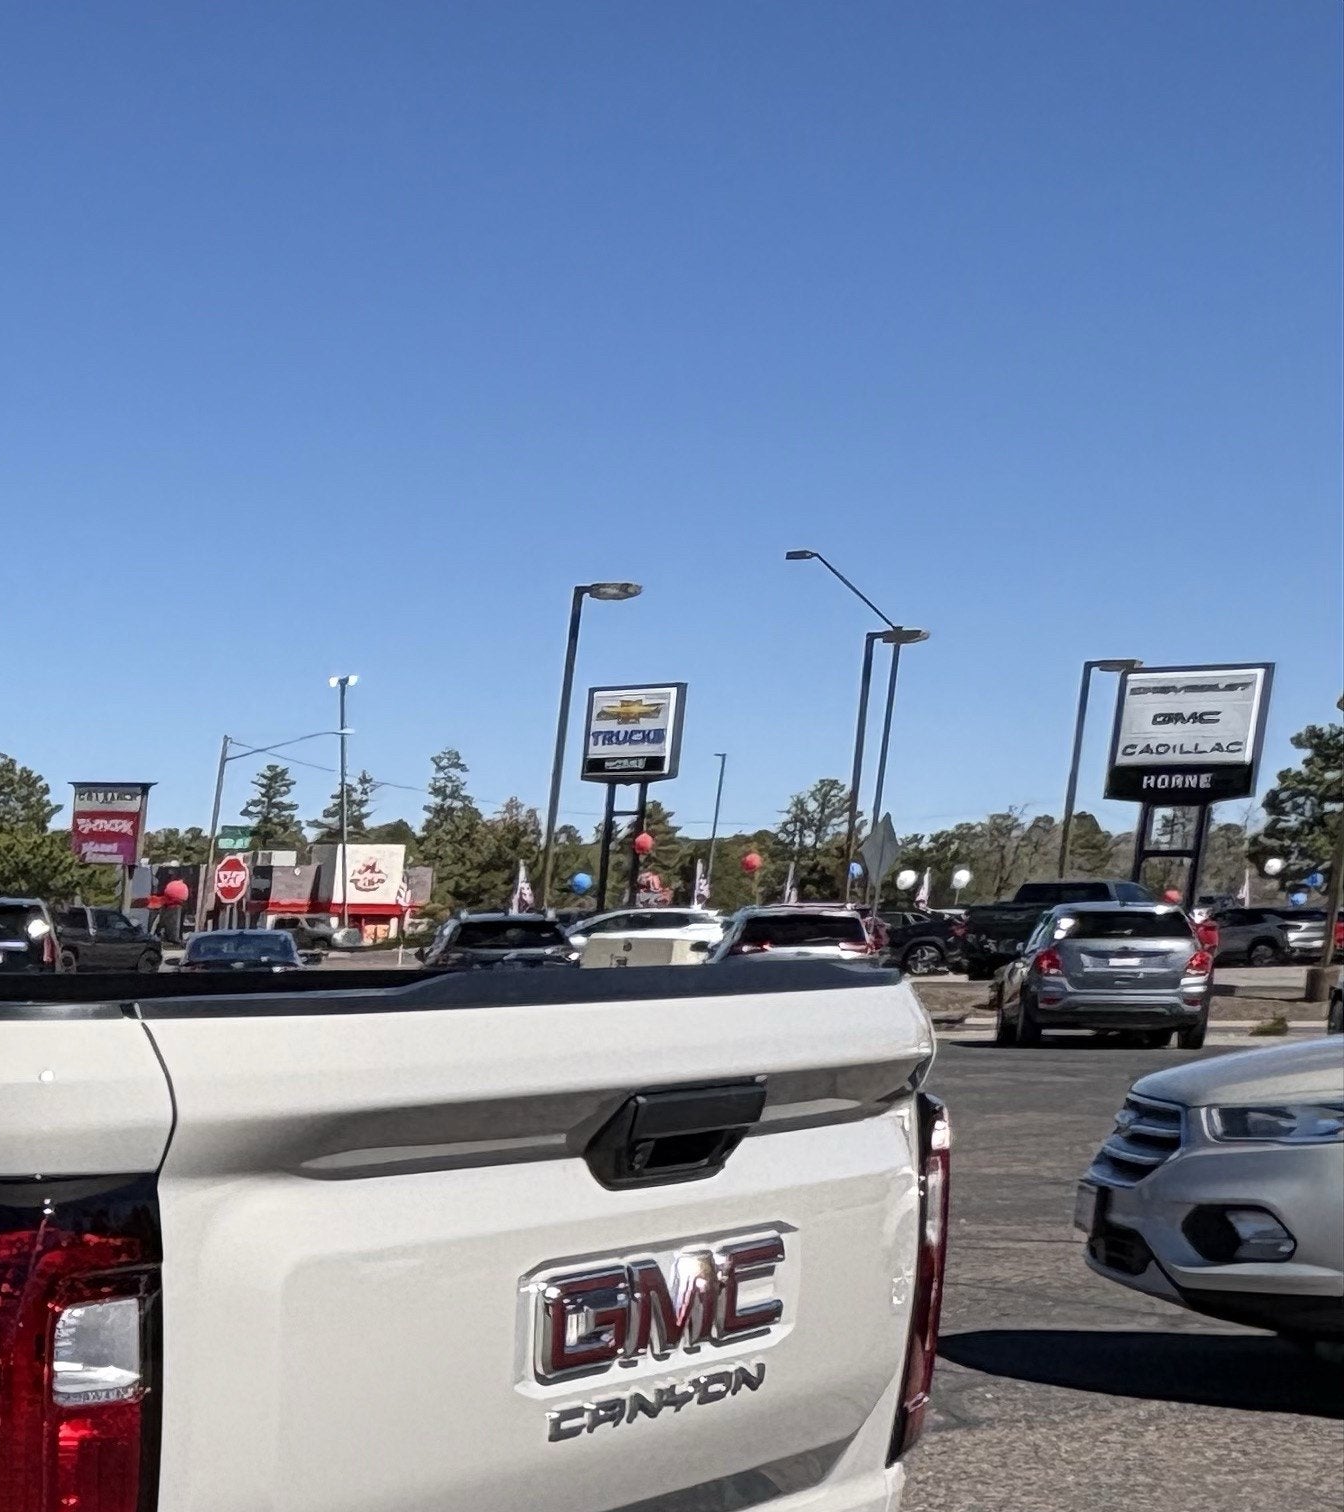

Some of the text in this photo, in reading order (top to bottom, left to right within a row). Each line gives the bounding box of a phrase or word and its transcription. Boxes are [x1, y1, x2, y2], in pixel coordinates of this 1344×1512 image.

[1151, 711, 1222, 725] GMC
[591, 728, 666, 746] TRUCKS
[1121, 741, 1243, 757] CADILLAC
[1142, 773, 1214, 789] HORNE
[533, 1236, 786, 1386] GMC
[545, 1361, 766, 1443] CANYON
